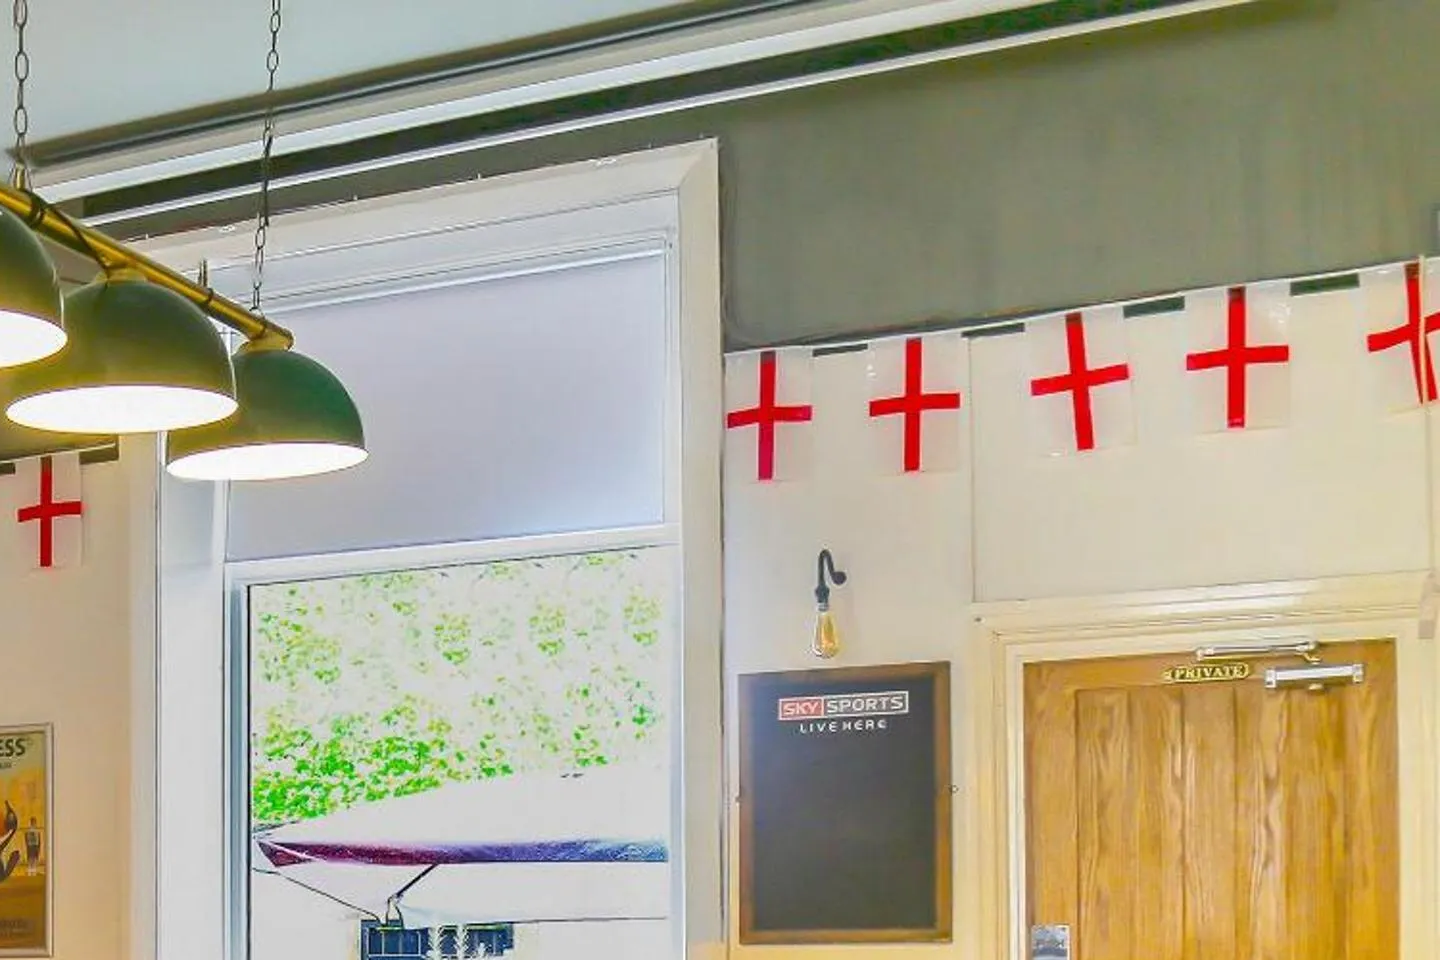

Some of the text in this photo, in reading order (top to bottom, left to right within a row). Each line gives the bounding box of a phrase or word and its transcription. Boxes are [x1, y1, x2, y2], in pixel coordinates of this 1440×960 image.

[1174, 665, 1244, 680] PRIVATE
[783, 695, 904, 716] SKY SPORTS
[799, 719, 889, 733] LIVE HERE
